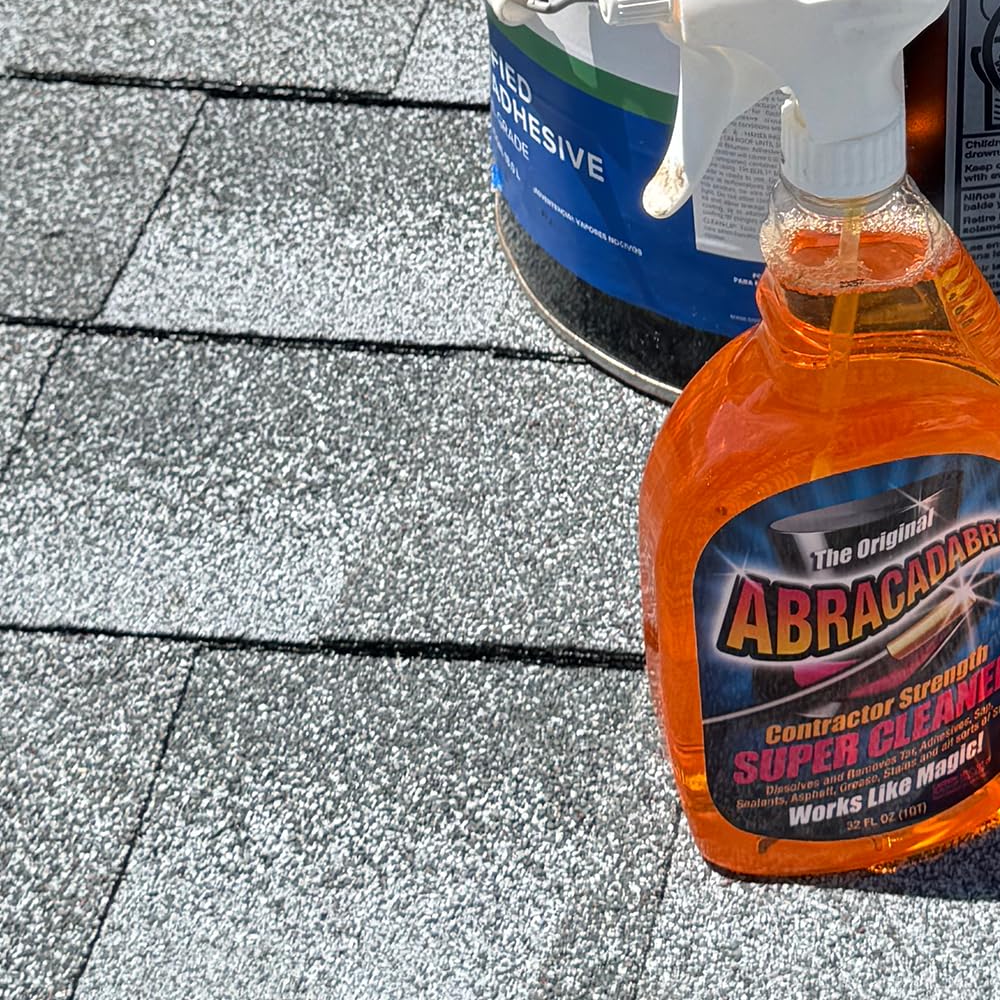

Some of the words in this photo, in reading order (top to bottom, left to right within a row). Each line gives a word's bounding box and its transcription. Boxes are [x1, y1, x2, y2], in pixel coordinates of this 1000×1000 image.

[492, 73, 605, 183] ADHESIVE
[964, 164, 993, 173] Keep
[964, 172, 988, 182] with
[964, 192, 996, 202] Niños
[964, 200, 994, 212] balde
[964, 214, 996, 224] Retire
[814, 546, 852, 570] The
[858, 508, 935, 560] Original
[765, 697, 895, 745] Contractor
[899, 644, 989, 710] Strength
[733, 732, 860, 785] SUPER
[736, 796, 788, 810] Sealants,
[790, 787, 837, 805] Asphalt,
[840, 774, 880, 792] Grease,
[883, 761, 917, 779] Stains
[920, 746, 939, 764] and
[766, 780, 820, 796] Dissolves
[823, 772, 844, 785] and
[847, 755, 897, 780] Removes
[788, 794, 863, 827] Works
[868, 776, 912, 809] Like
[916, 730, 984, 790] Magic!
[846, 820, 860, 832] 32
[864, 817, 878, 828] FL
[880, 812, 896, 824] OZ
